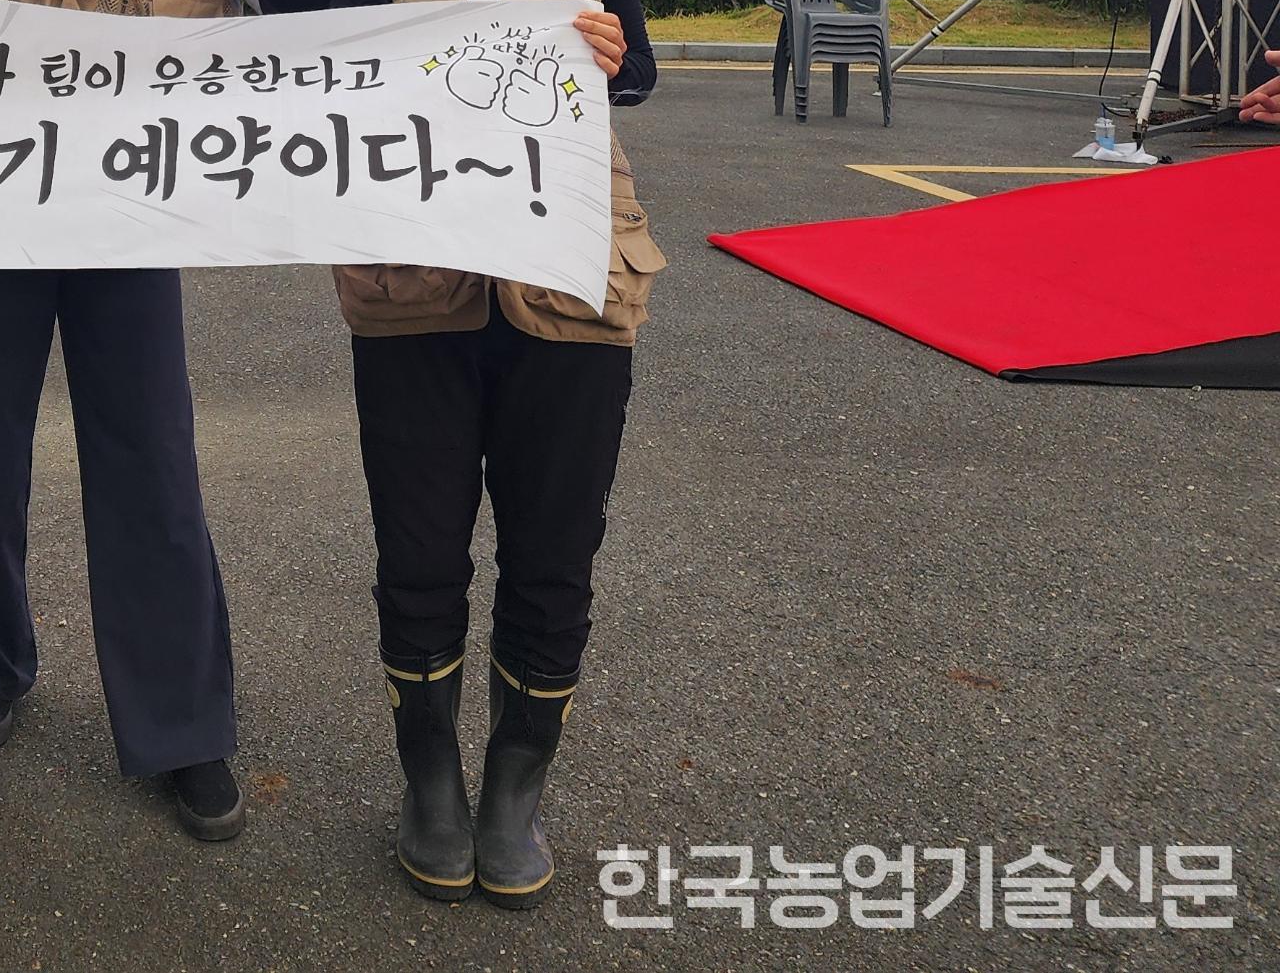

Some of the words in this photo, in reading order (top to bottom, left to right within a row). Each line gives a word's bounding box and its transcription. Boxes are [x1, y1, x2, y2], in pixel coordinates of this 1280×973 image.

[40, 48, 126, 98] 팀이
[148, 52, 385, 97] 우승한다고
[101, 113, 549, 218] 예약이다~!
